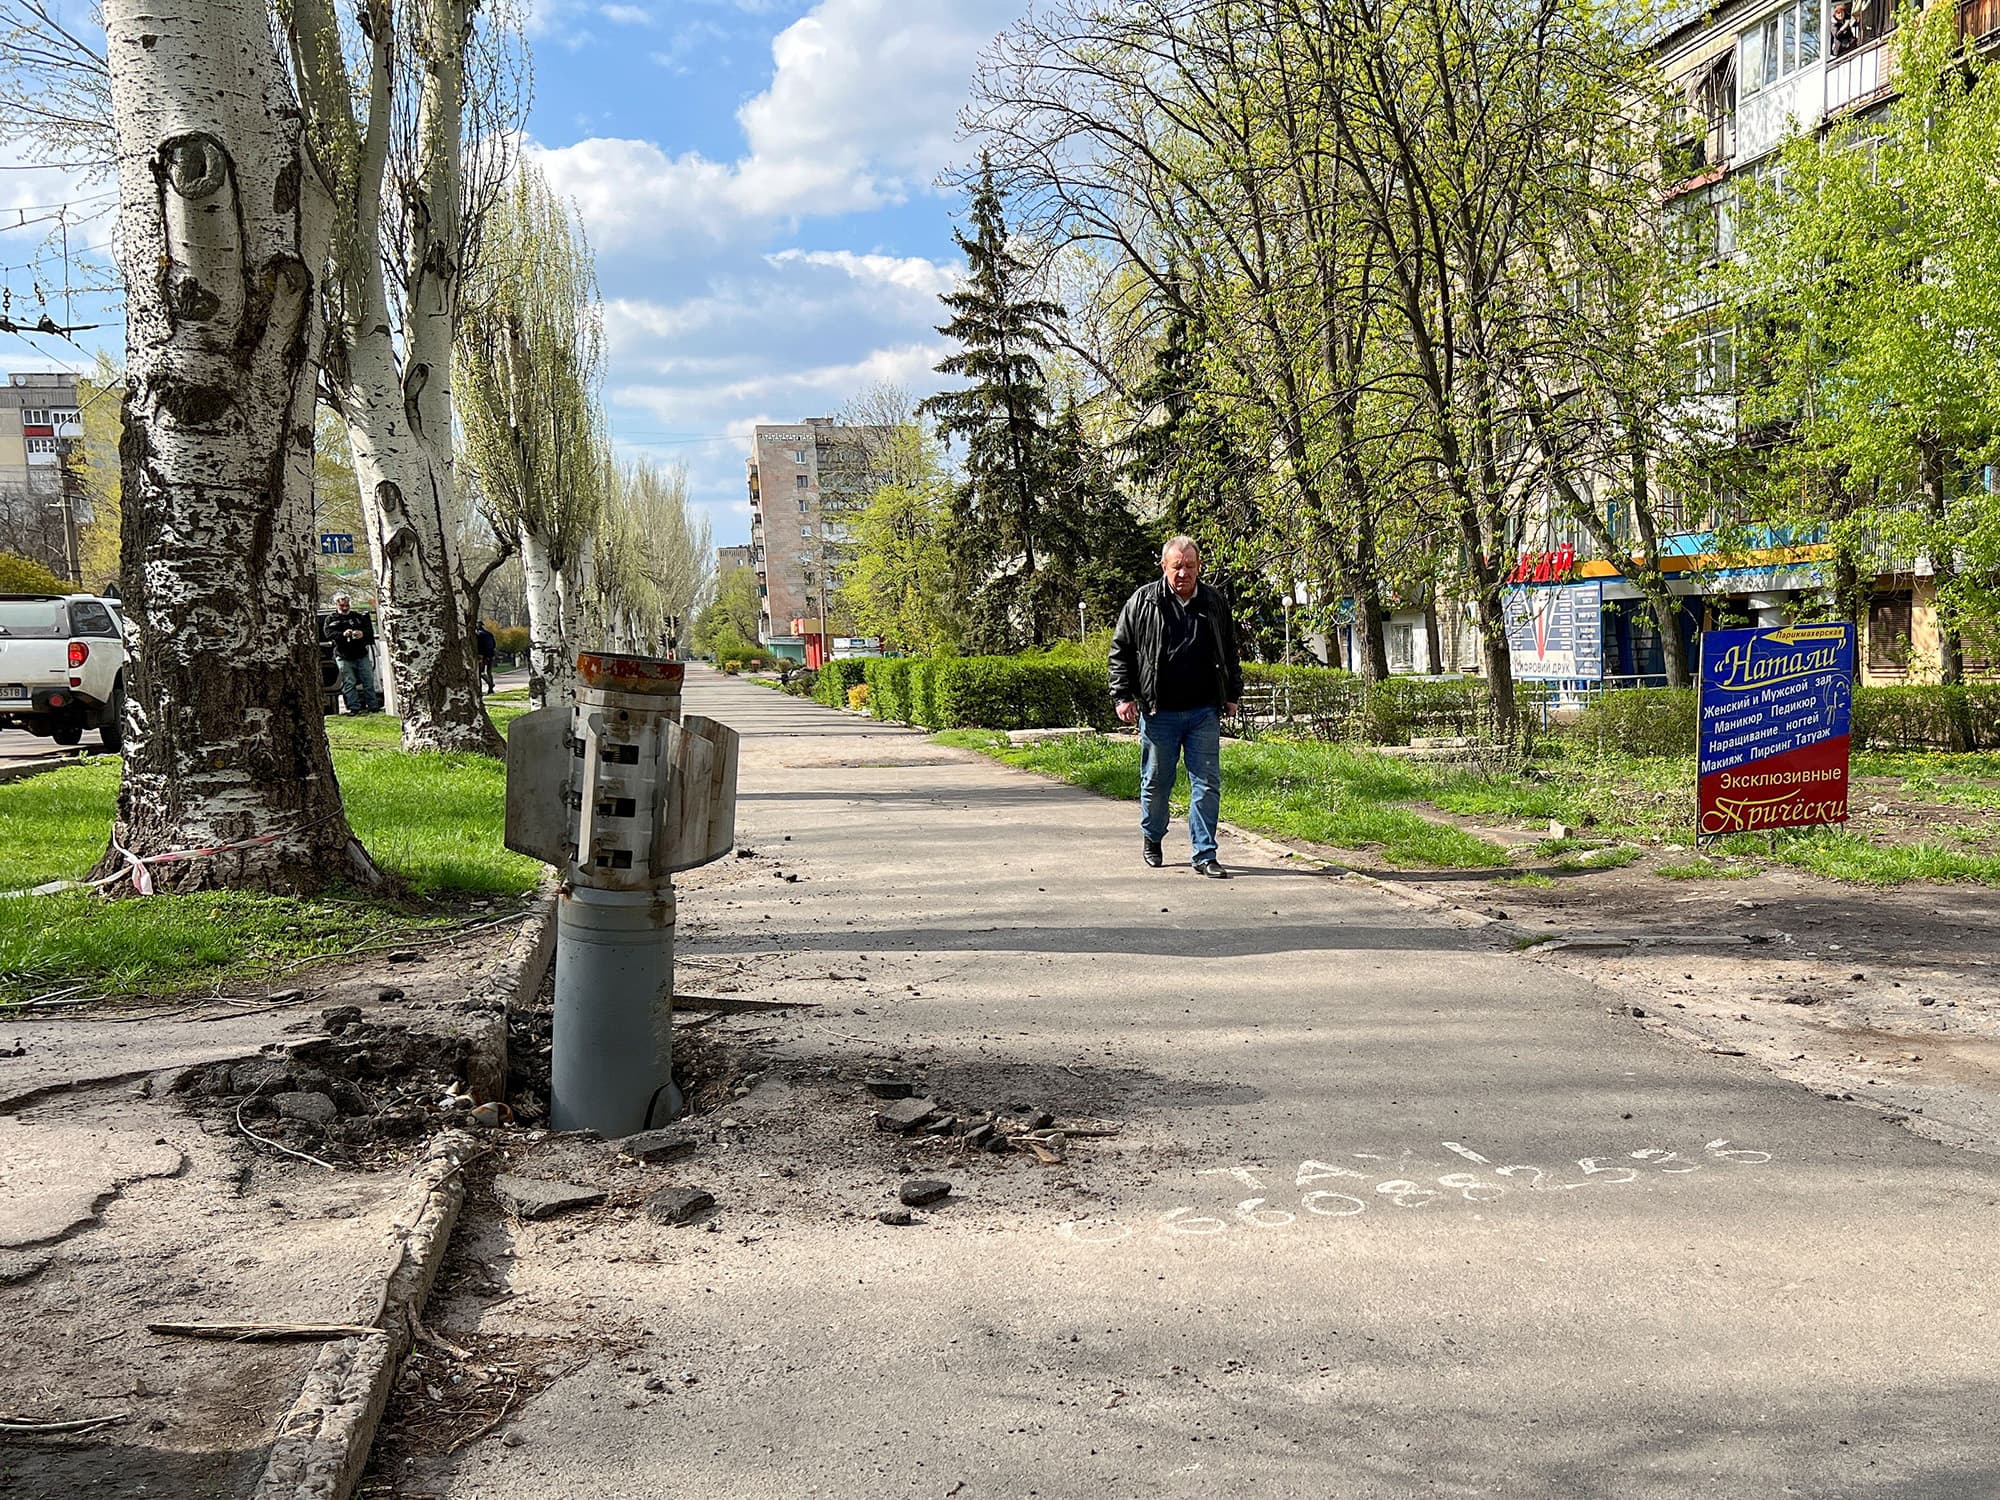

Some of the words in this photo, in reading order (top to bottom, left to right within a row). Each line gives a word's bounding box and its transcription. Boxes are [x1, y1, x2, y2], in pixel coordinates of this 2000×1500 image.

[1775, 629, 1843, 639] Парикмахерская
[1552, 663, 1570, 675] ДРУК
[1704, 695, 1750, 720] Женский
[1752, 695, 1759, 705] и
[1761, 678, 1808, 704] Мужской
[1815, 674, 1832, 687] зал
[1714, 712, 1763, 735] Маникюр
[1771, 695, 1817, 718] Педикюр
[1701, 752, 1743, 774] Макияж
[1750, 738, 1792, 761] Пирсинг
[1795, 727, 1831, 747] Татуаж
[1709, 726, 1778, 753] Наращивание
[1786, 711, 1819, 732] ногтей
[1720, 768, 1842, 789] Эксклюзивные
